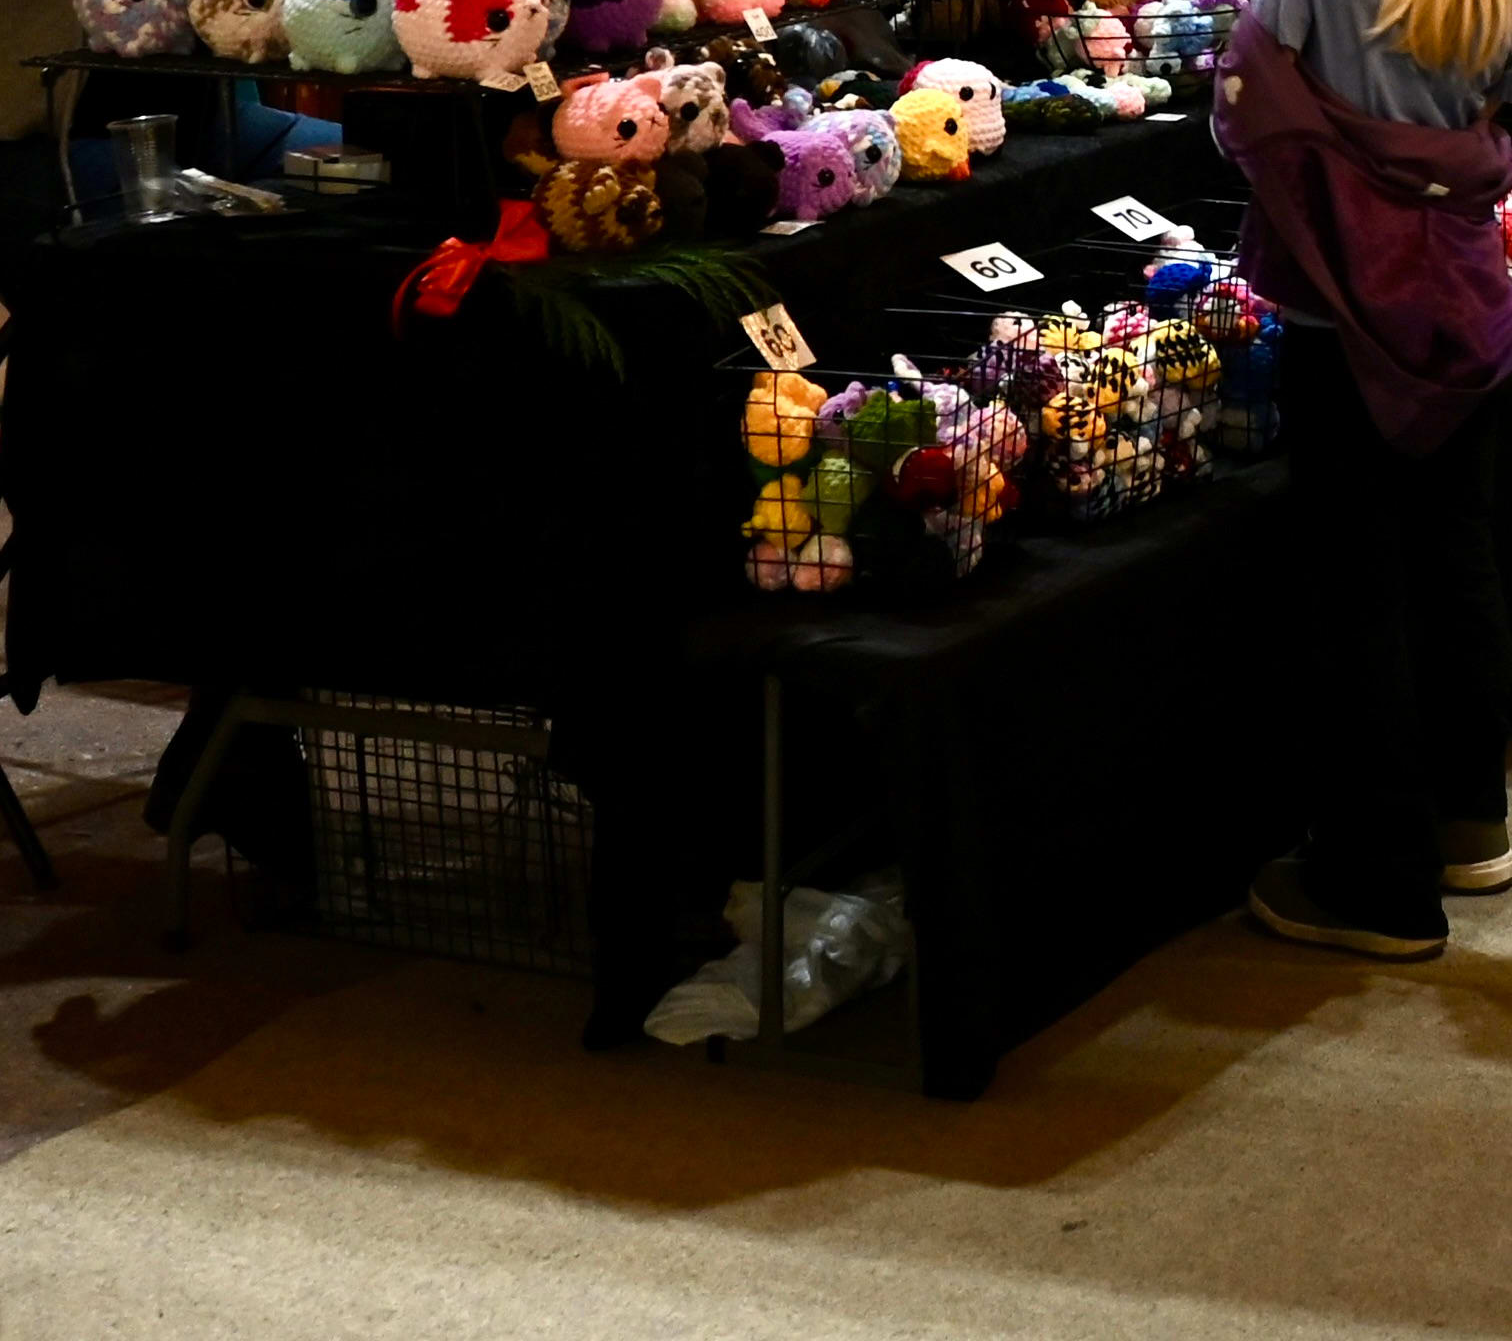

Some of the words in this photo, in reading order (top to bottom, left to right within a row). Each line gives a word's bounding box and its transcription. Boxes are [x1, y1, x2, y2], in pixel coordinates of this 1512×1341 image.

[1111, 208, 1153, 230] 70
[969, 256, 1018, 279] 60
[760, 323, 797, 358] 60
